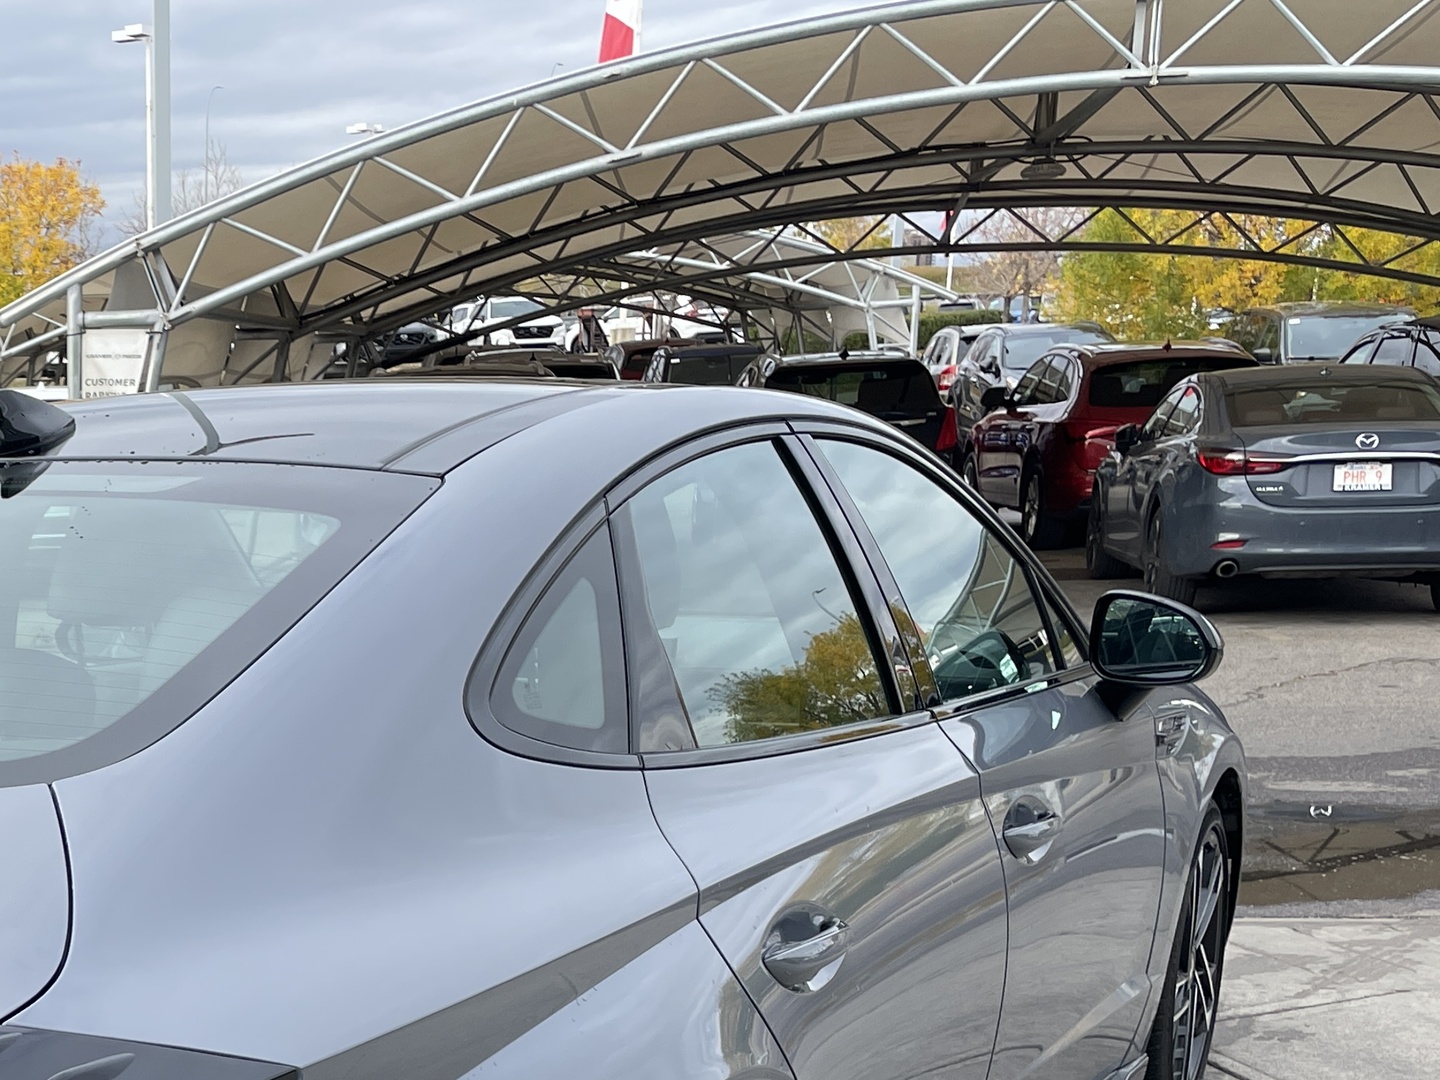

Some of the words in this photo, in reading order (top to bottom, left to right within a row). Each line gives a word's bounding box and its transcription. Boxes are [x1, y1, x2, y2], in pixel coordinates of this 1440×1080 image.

[85, 378, 136, 387] CUSTOMER
[1343, 470, 1367, 483] PHR
[1375, 470, 1383, 483] 9
